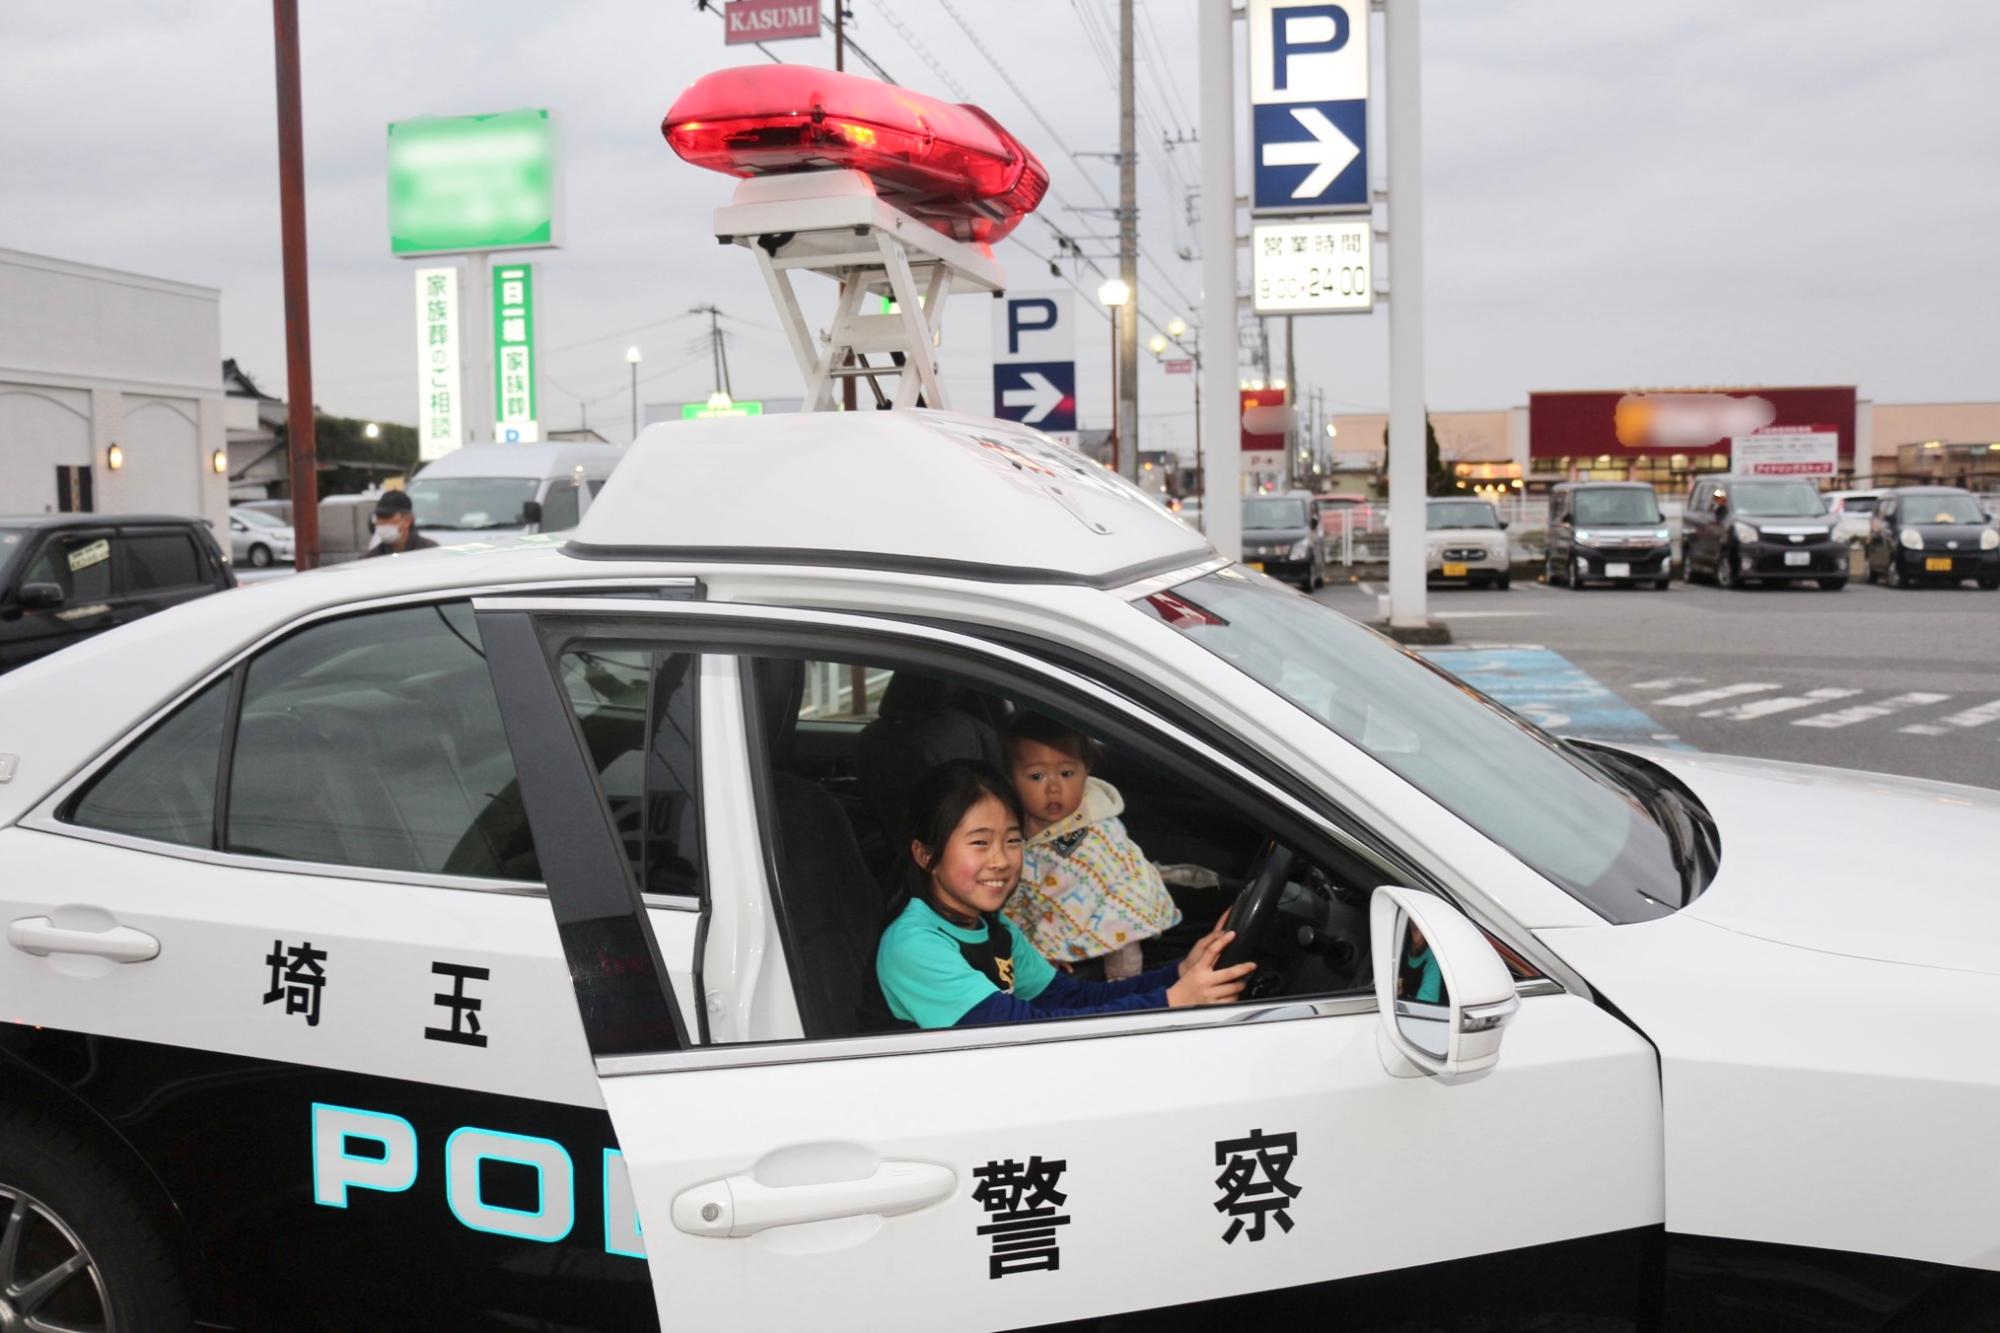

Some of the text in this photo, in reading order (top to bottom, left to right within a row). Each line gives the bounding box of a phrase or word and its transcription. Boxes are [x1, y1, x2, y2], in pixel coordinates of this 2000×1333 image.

[730, 6, 814, 32] KASUMI
[1271, 4, 1350, 91] P
[1008, 298, 1058, 354] P
[971, 1128, 1303, 1280] 警察
